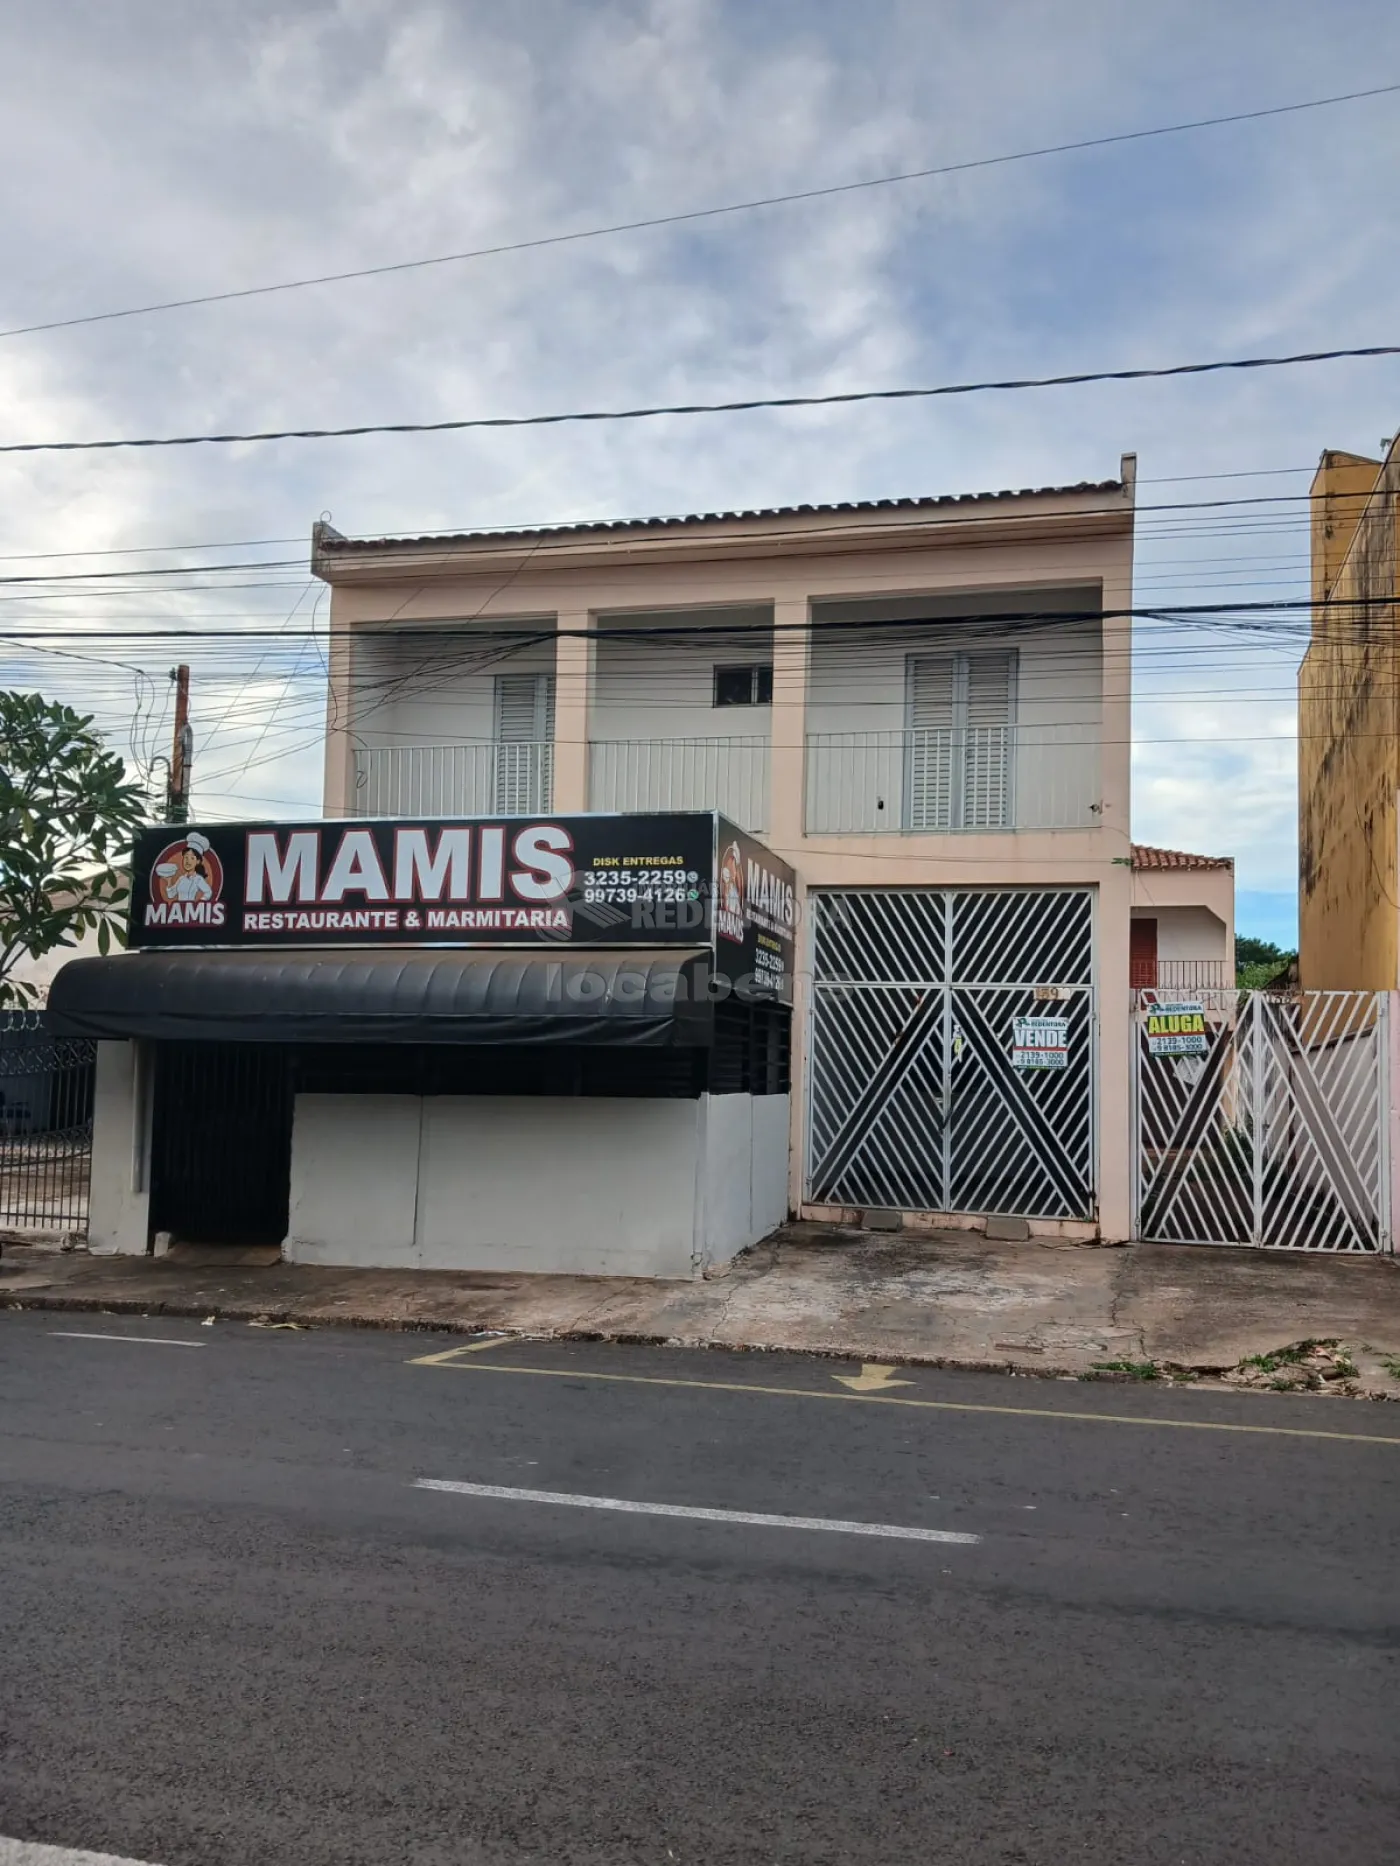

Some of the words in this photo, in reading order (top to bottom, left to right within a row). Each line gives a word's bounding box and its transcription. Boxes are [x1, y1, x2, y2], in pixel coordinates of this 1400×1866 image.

[244, 824, 574, 904] MAMIS
[593, 857, 619, 867] DISK
[622, 856, 684, 866] ENTREGAS
[584, 869, 687, 886] 3235-2259
[584, 887, 687, 903] 99739-4126
[747, 857, 793, 926] MAMIS
[145, 901, 226, 927] MAMIS
[244, 910, 397, 931] RESTAURANTE
[404, 910, 421, 928] &
[427, 908, 569, 929] MARMITARIA
[1149, 1014, 1204, 1033] ALUGA
[1014, 1029, 1067, 1047] VENDE
